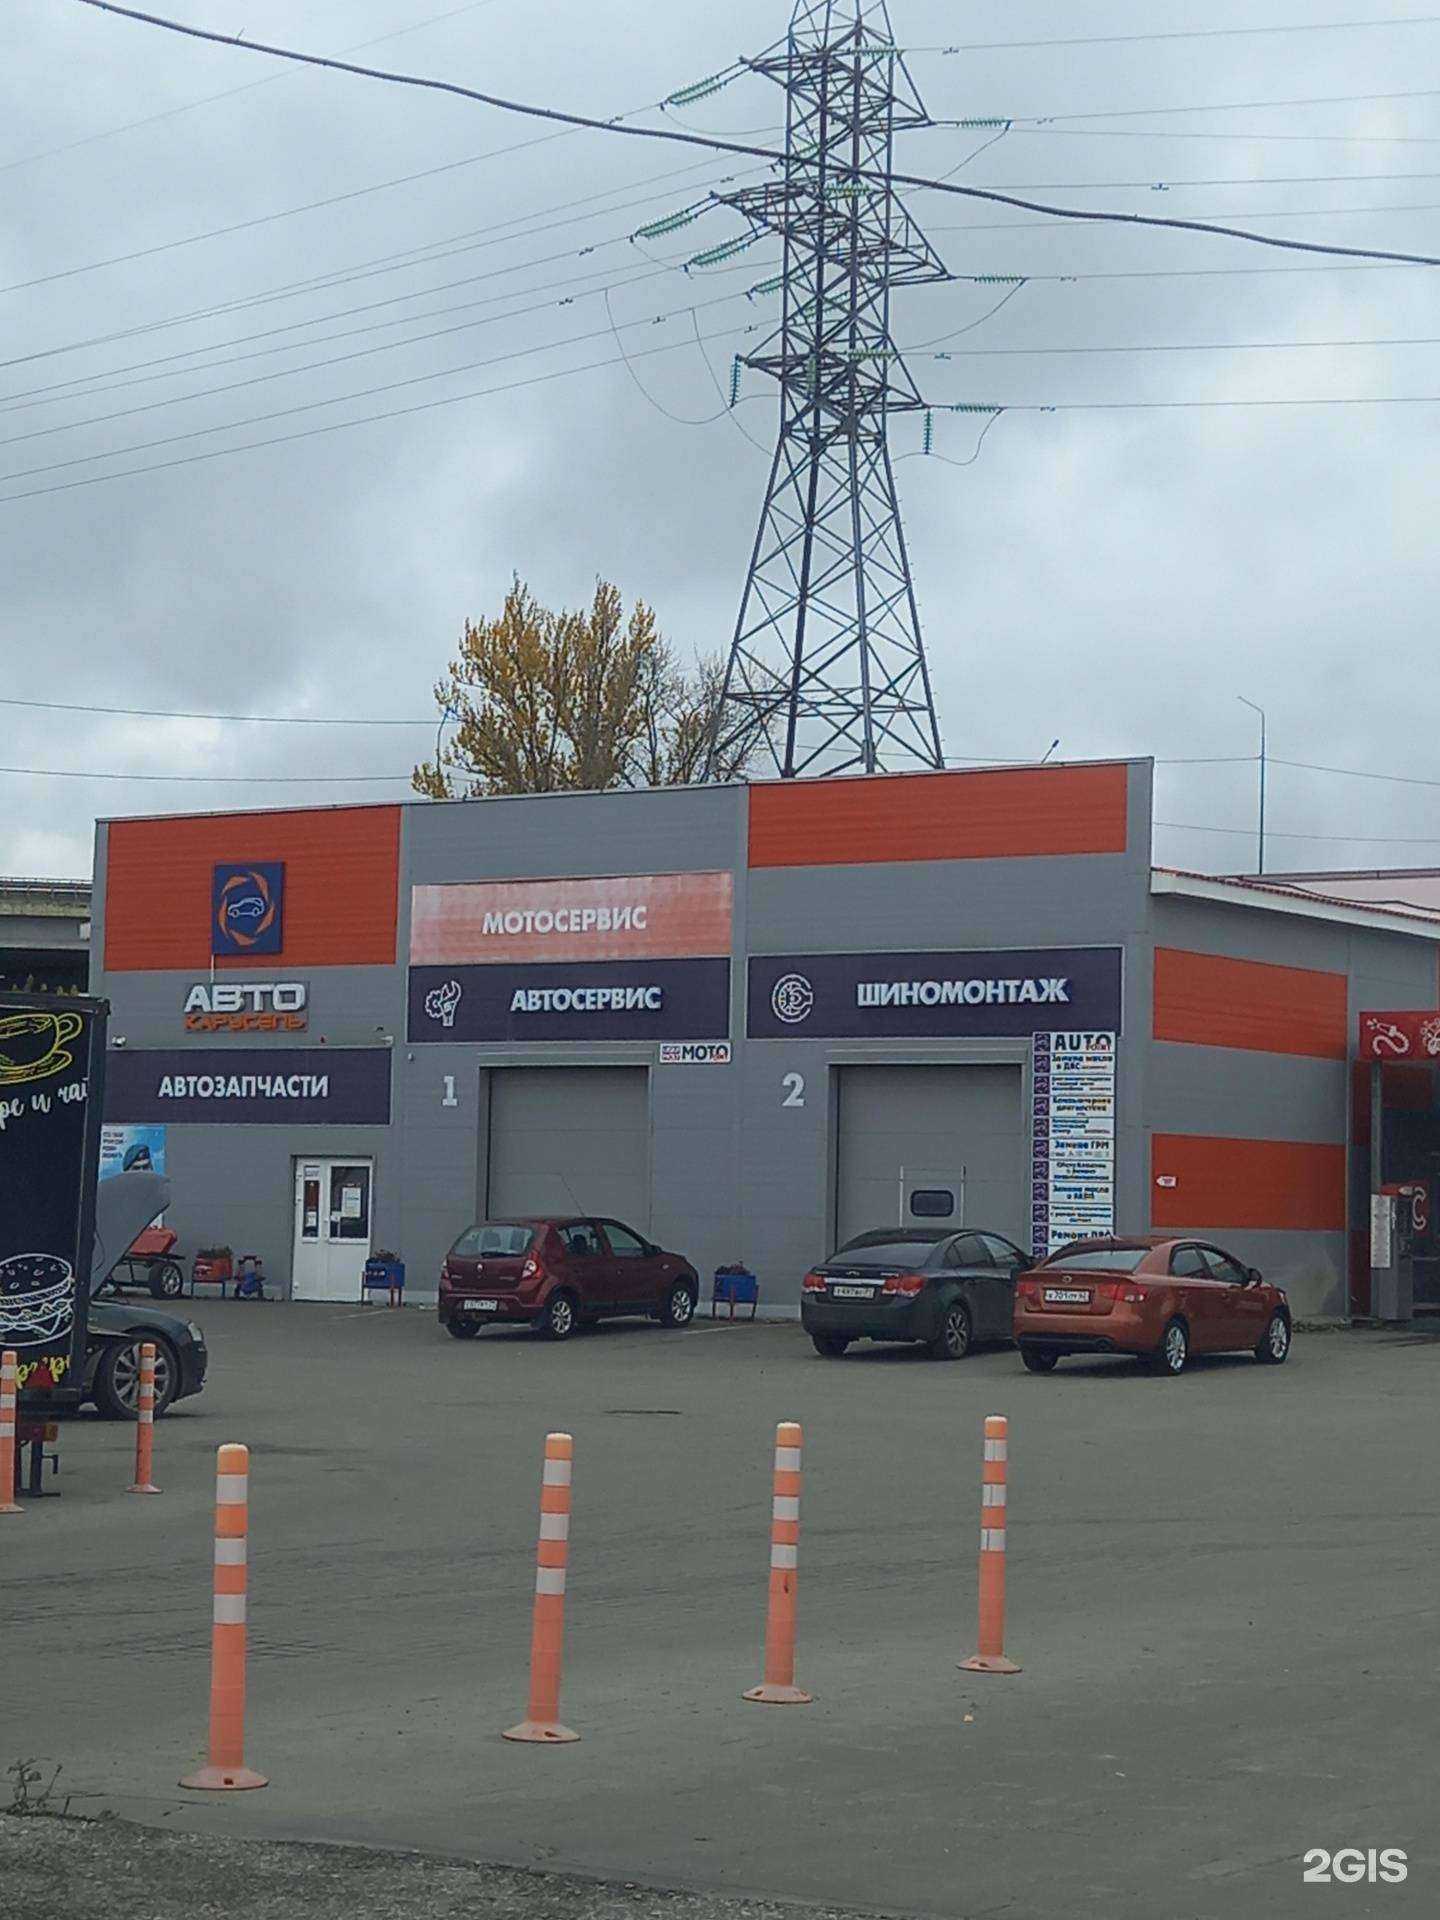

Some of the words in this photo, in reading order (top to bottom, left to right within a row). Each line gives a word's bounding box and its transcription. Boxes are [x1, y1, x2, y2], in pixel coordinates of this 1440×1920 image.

[482, 906, 647, 935] МОТОСЕРВИС
[184, 983, 306, 1013] АВТО
[510, 986, 662, 1013] АВТОСЕРВИС
[857, 977, 1070, 1007] ШИНОМОНТАЖ
[183, 1014, 307, 1031] КАРУСЕЛЬ
[158, 1075, 330, 1098] АВТОЗАПЧАСТИ
[441, 1076, 458, 1107] 1
[781, 1073, 806, 1107] 2
